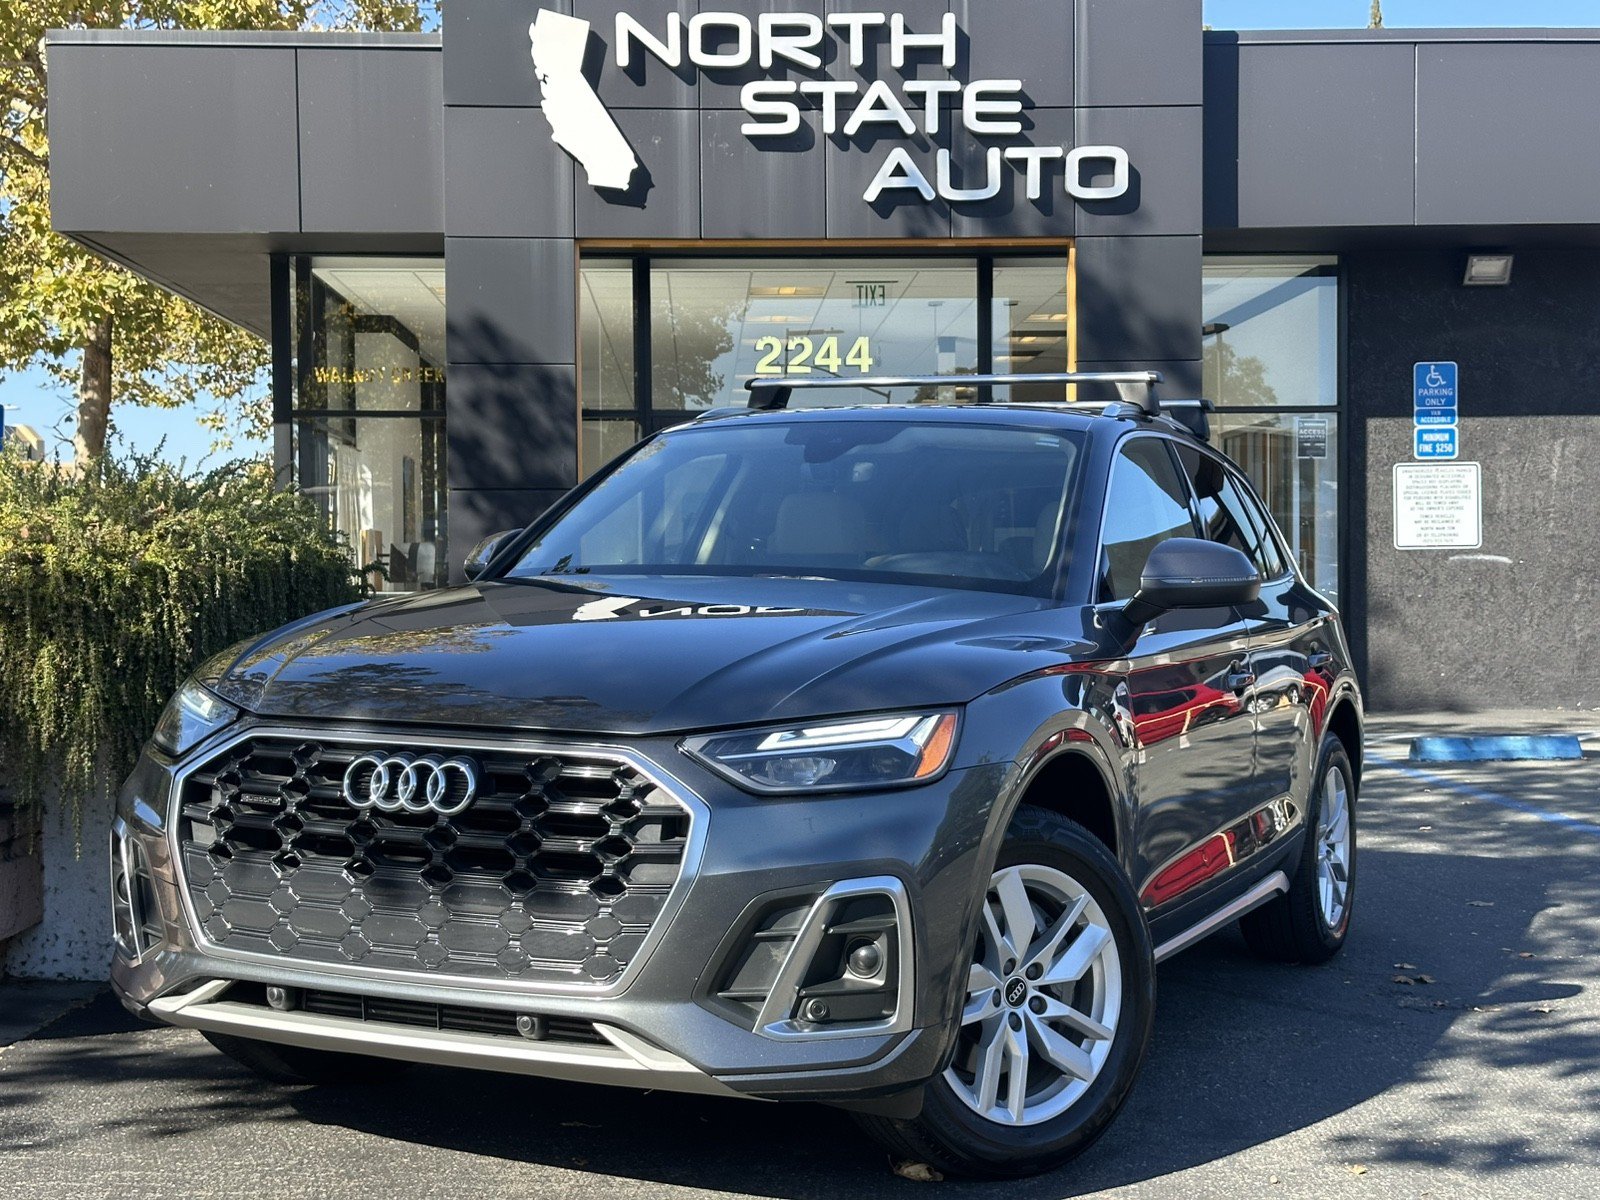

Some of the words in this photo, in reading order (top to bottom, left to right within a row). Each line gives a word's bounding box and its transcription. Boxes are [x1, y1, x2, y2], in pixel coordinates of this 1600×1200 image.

[615, 11, 956, 69] NORTH
[740, 79, 1022, 136] STATE
[863, 145, 1129, 202] AUTO
[755, 336, 873, 373] 2244
[1418, 388, 1453, 397] PARKING
[1425, 398, 1446, 406] ONLY
[1419, 444, 1433, 453] FINE
[1435, 443, 1454, 454] $250
